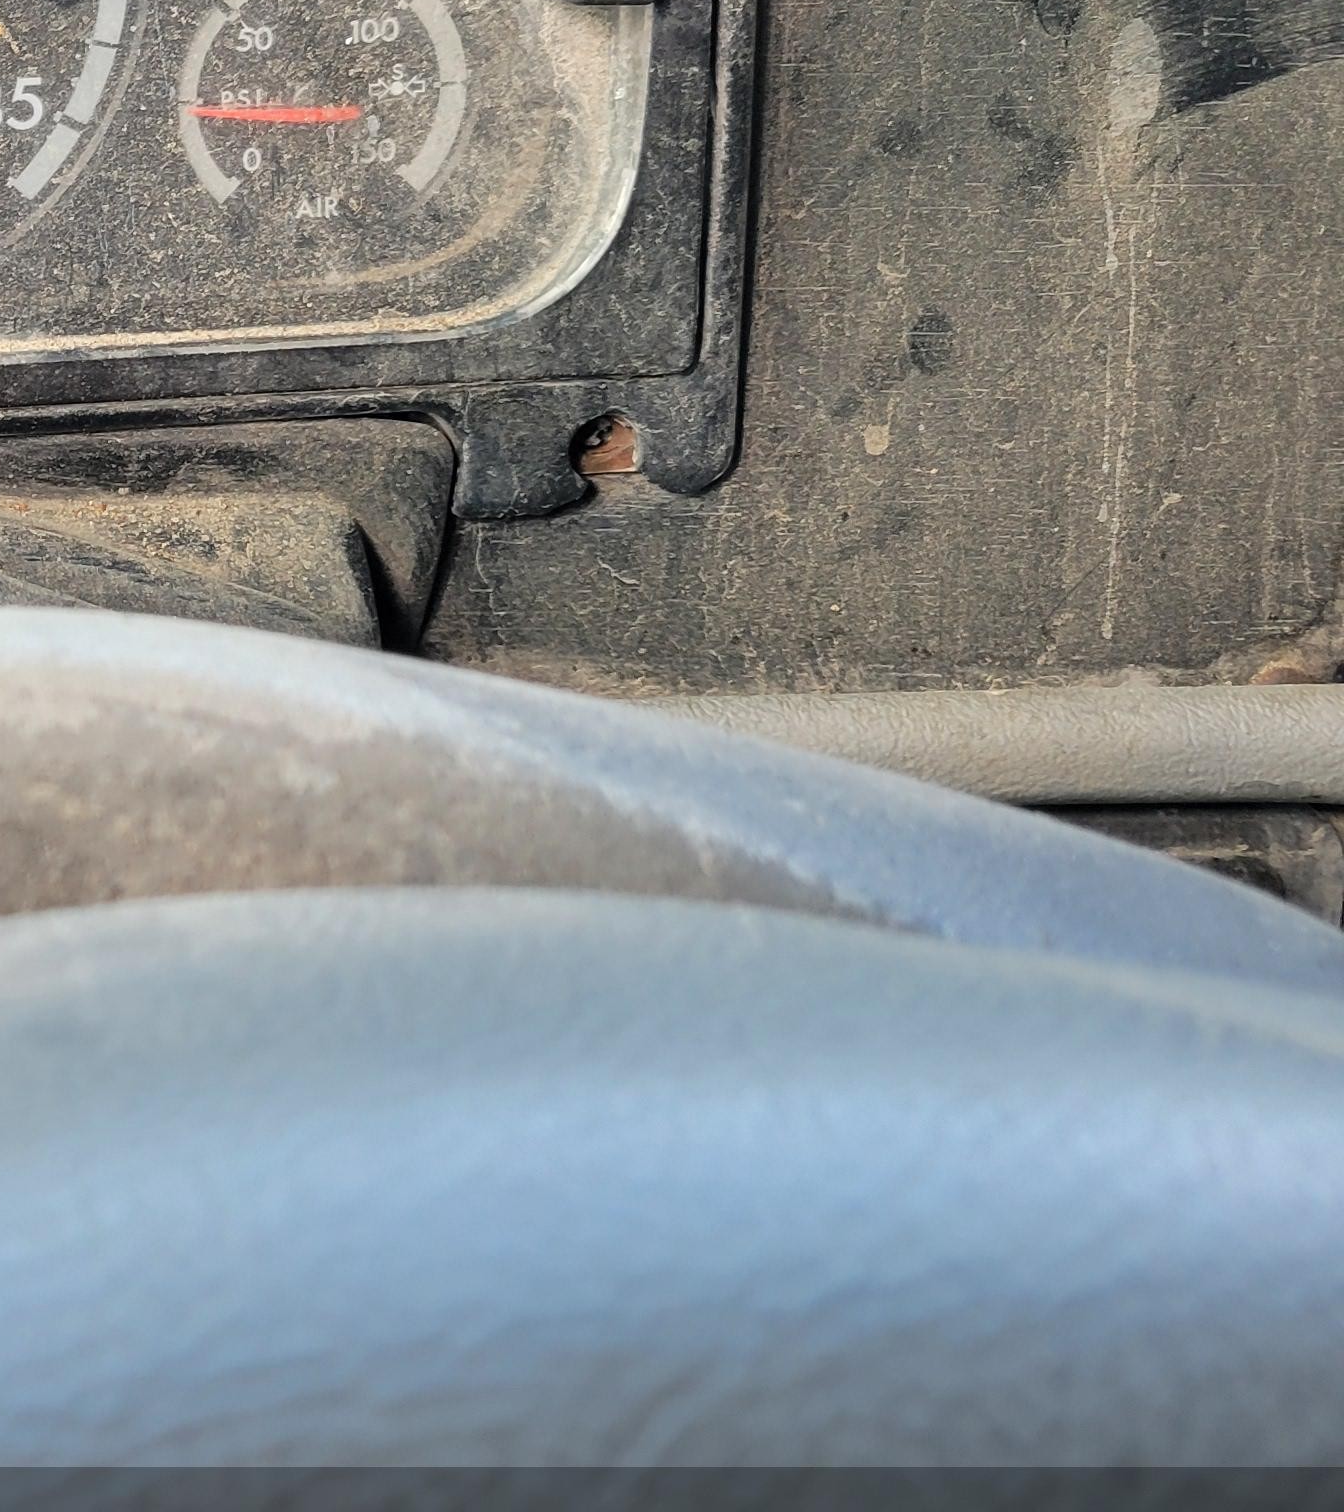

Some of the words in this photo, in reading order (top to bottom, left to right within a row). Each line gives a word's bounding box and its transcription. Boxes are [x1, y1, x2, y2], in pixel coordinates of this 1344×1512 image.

[235, 26, 274, 53] 50
[349, 17, 400, 45] 100
[242, 147, 262, 172] 0
[294, 195, 340, 219] AIR
